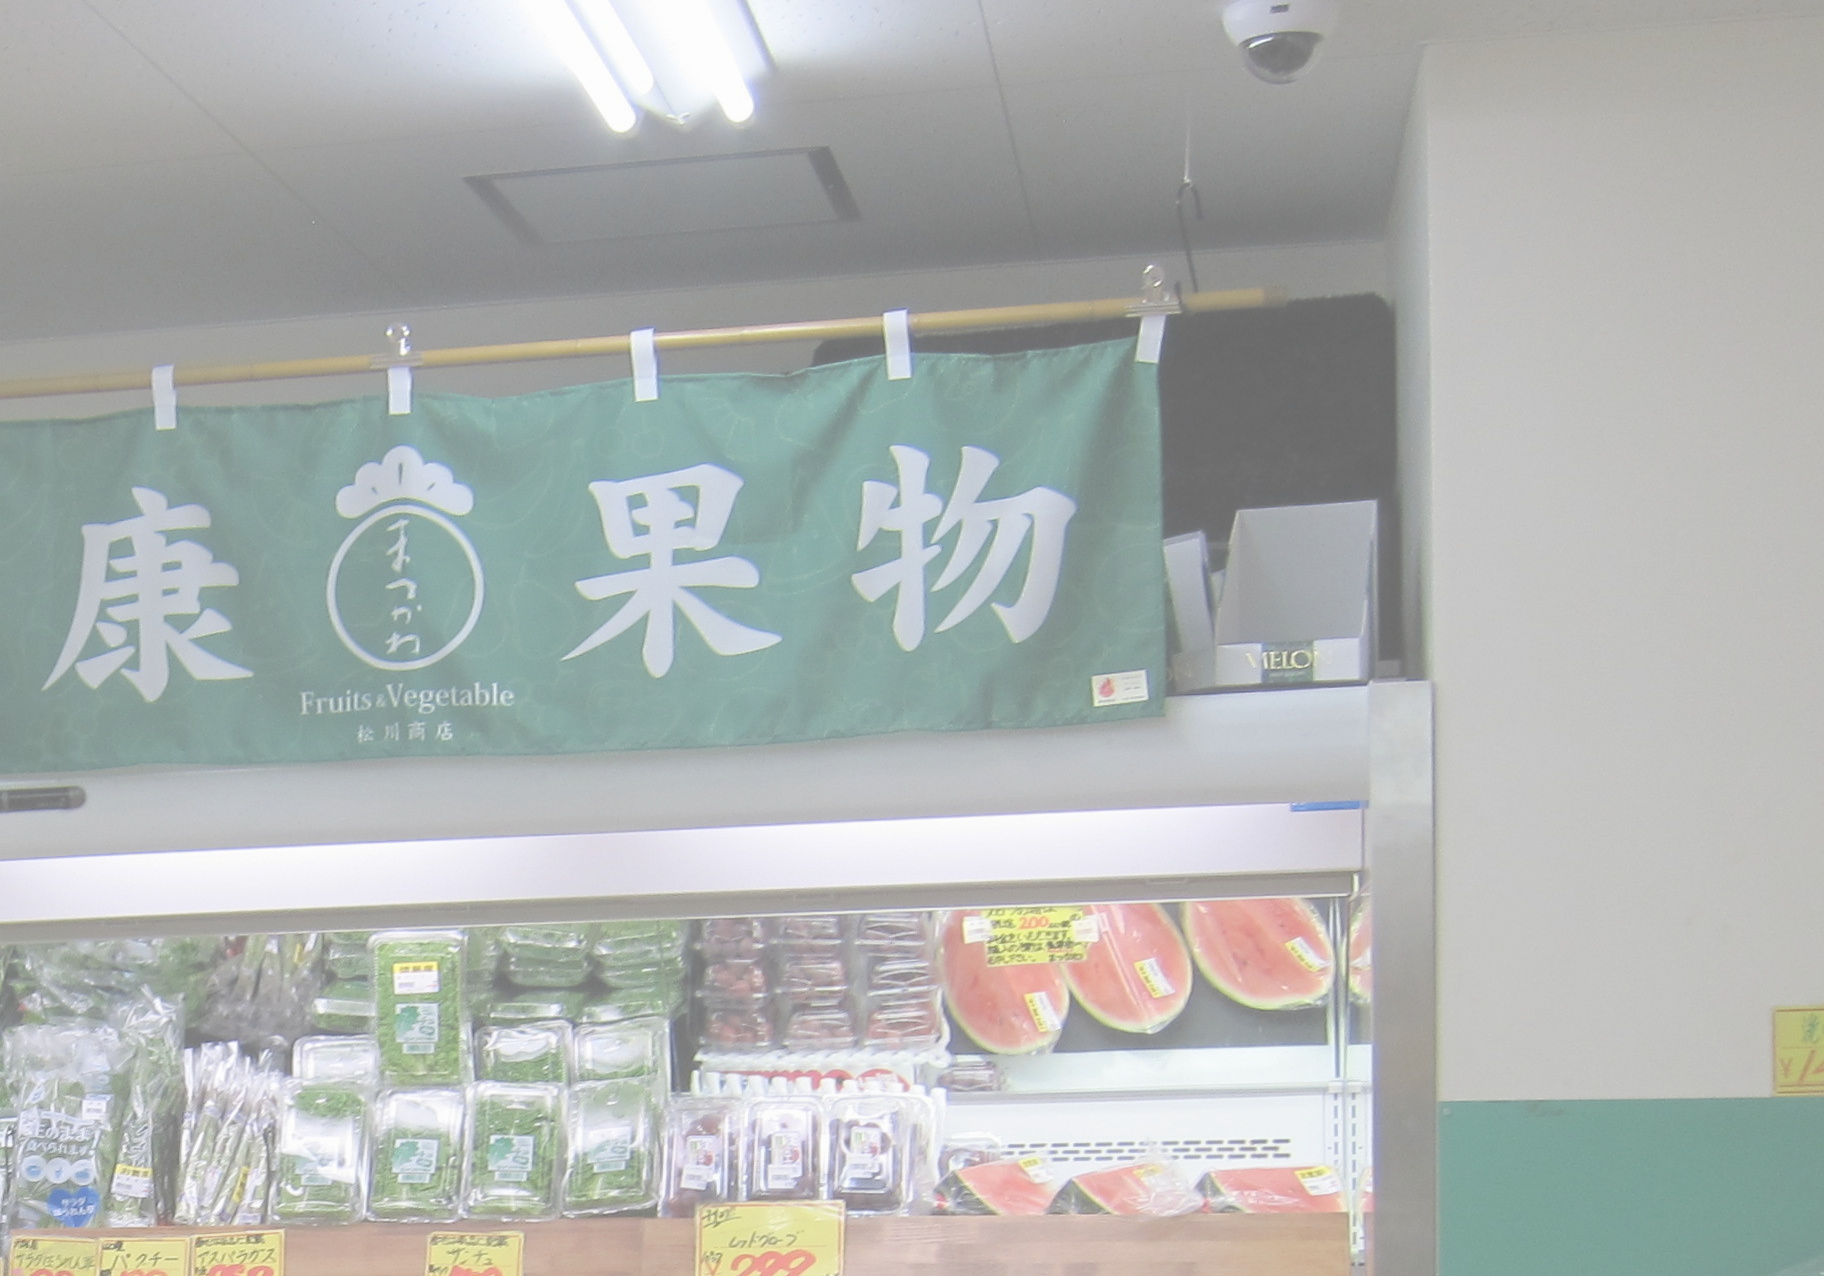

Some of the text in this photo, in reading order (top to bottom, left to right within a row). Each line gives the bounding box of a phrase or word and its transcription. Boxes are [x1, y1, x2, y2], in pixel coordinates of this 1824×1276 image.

[563, 443, 1076, 677] 果物
[356, 721, 455, 744] 松川商店
[110, 1252, 180, 1270] パクチー
